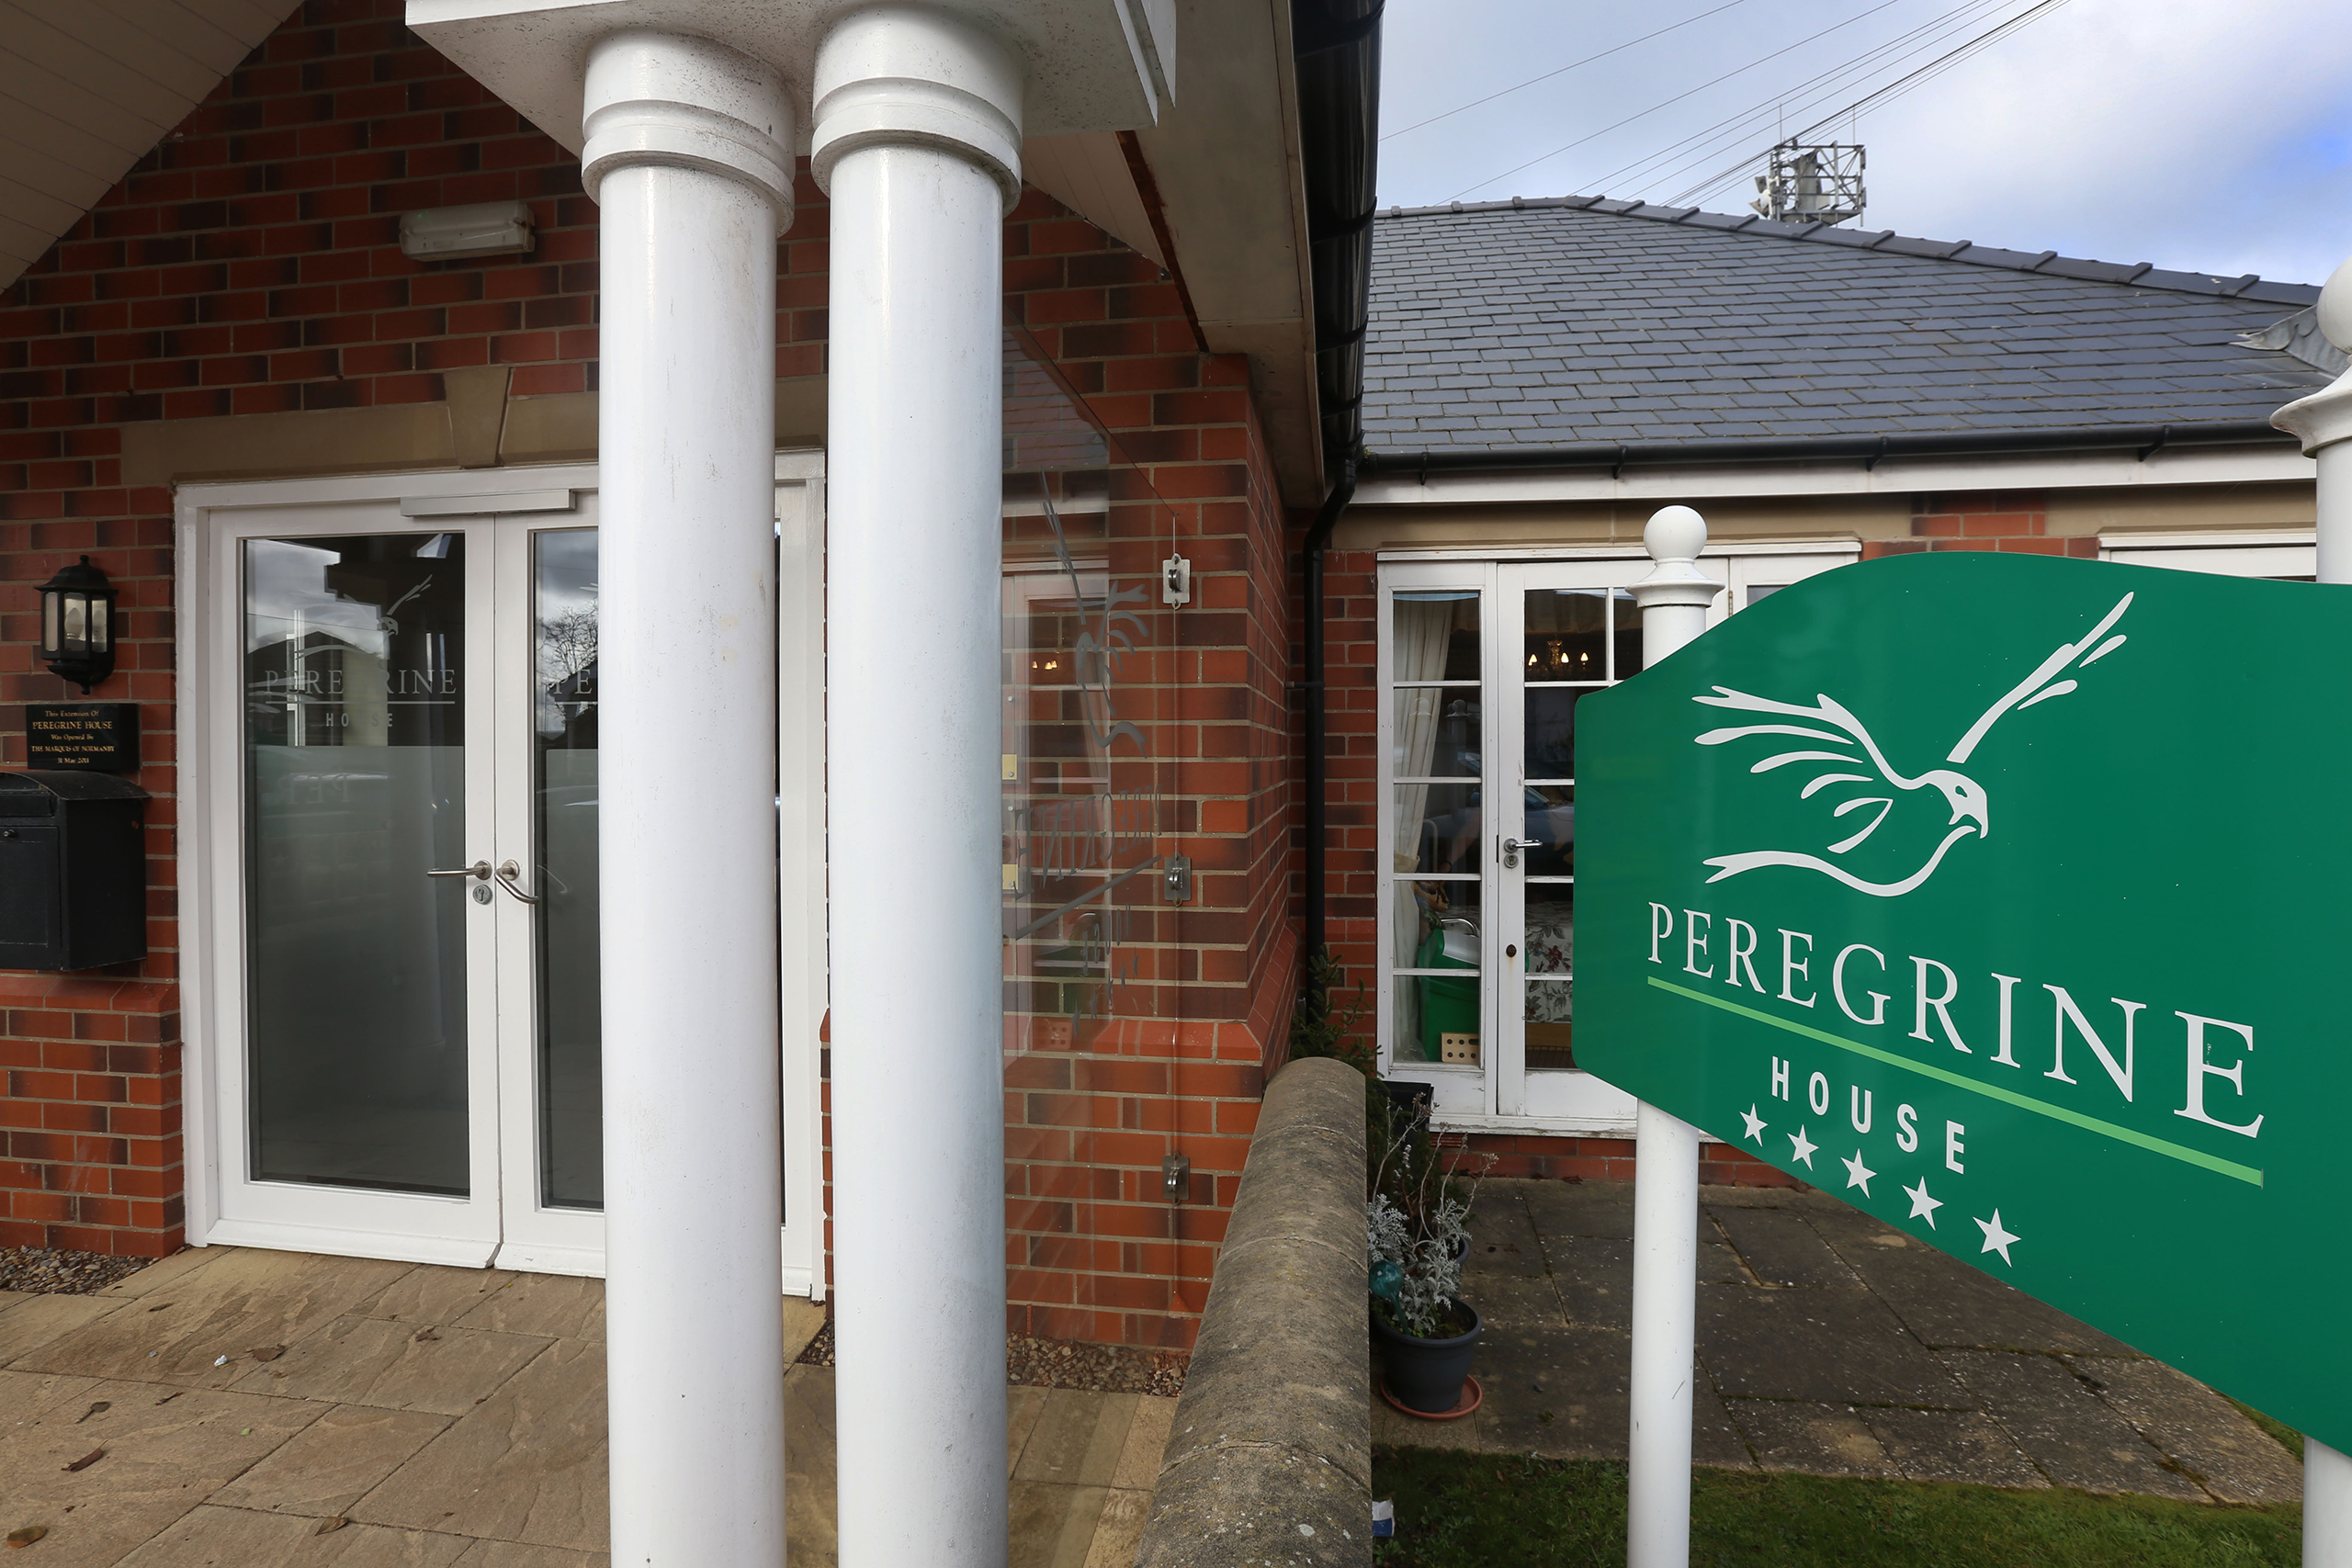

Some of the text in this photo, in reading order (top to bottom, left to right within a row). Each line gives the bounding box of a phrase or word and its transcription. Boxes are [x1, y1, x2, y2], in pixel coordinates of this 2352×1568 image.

[264, 669, 458, 695] PRERINE
[32, 721, 113, 729] PEREGRINE HOUSE
[324, 712, 393, 728] HOSE
[63, 733, 85, 741] Opened
[1647, 901, 2265, 1139] PEREGRINE
[1771, 1055, 1966, 1175] HOUSE
